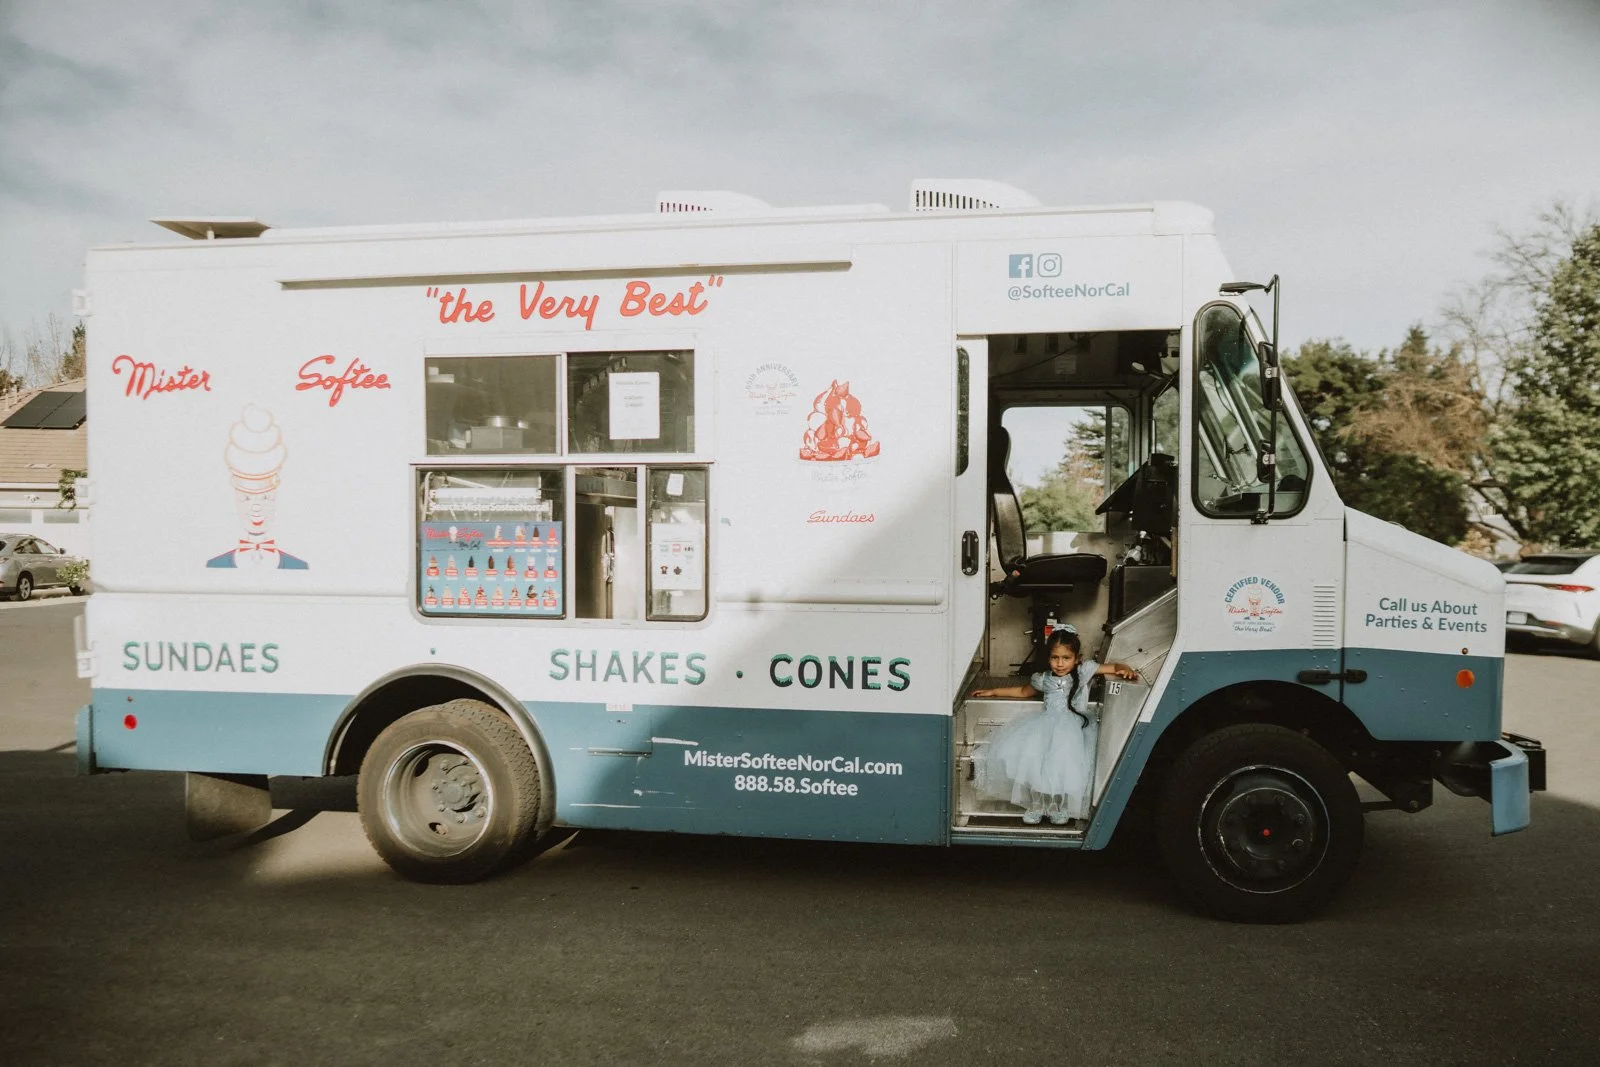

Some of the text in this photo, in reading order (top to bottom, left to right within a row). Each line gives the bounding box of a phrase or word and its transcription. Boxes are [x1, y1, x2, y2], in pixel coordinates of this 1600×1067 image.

[426, 275, 723, 330] "the Very Best"
[1008, 282, 1130, 300] @SofteeNorCal
[112, 355, 392, 407] Mister Softee
[807, 510, 875, 523] Sundaes
[1224, 576, 1286, 604] CERTIFIED VENDOR
[1379, 597, 1478, 616] Call us About
[1365, 613, 1488, 633] Parties & Events
[123, 641, 279, 673] SUNDAES
[548, 647, 707, 686] SHAKES
[769, 653, 911, 692] CONES
[1111, 682, 1121, 695] 15
[684, 749, 903, 776] MisterSofteeNorCal.com
[734, 774, 859, 796] 888.58.Softee
